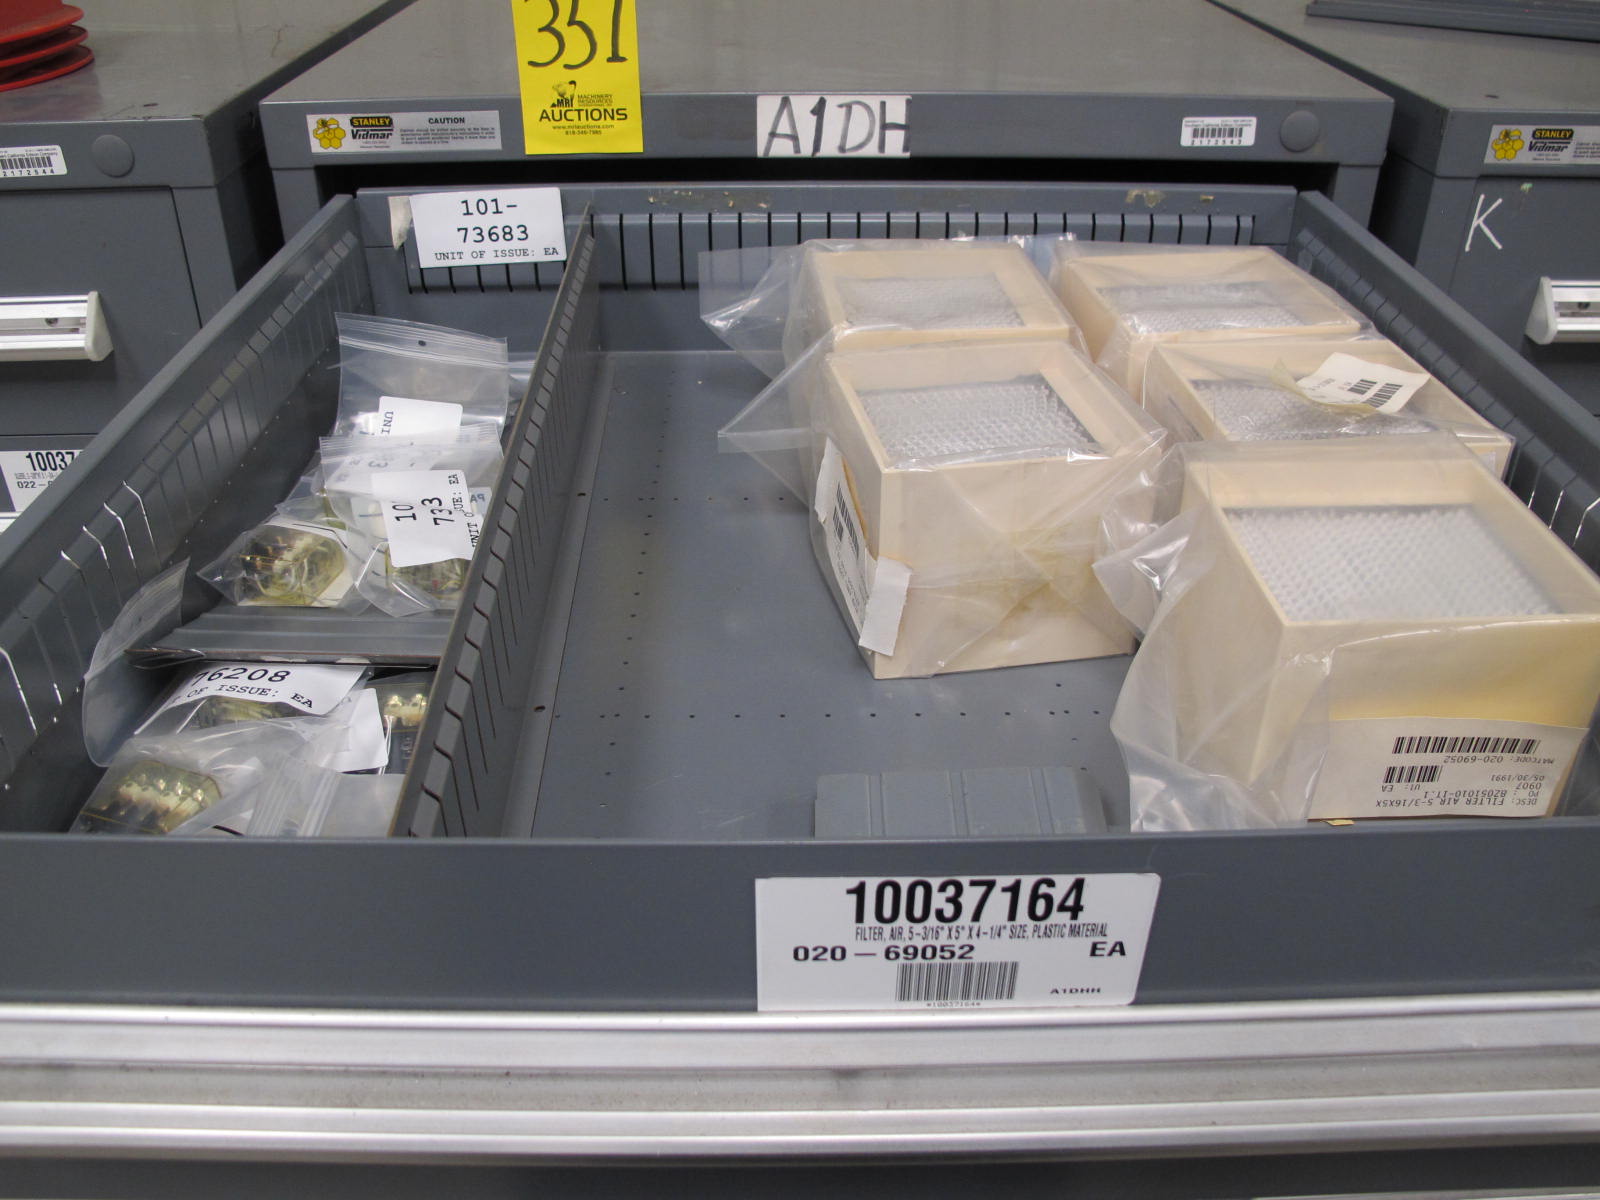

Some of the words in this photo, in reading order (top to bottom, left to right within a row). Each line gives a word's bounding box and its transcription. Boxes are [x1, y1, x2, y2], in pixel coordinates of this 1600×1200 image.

[352, 118, 391, 126] STANLEY
[539, 108, 628, 122] AUCTIONS
[763, 96, 912, 157] A1DH
[351, 129, 393, 140] Vidmar
[1534, 130, 1572, 138] STANLEY
[1528, 141, 1569, 152] Vidmar
[461, 198, 518, 216] 101-
[1465, 193, 1503, 252] K
[457, 224, 529, 244] 73683
[434, 251, 464, 261] UNIT
[471, 250, 486, 259] OF
[494, 248, 536, 258] ISSUE:
[543, 247, 559, 256] EA
[448, 473, 460, 486] EA
[392, 501, 417, 522] 10
[187, 687, 208, 698] OF
[216, 685, 279, 697] ISSUE:
[290, 692, 314, 709] EA
[1443, 756, 1504, 764] 020-69052
[1381, 784, 1394, 793] EA
[1515, 781, 1542, 790] 0907
[1439, 798, 1460, 806] AIR
[1465, 797, 1505, 806] FILTER
[845, 877, 1085, 924] 10037164
[855, 926, 887, 942] FILTER,
[890, 926, 907, 941] AIR,
[1008, 924, 1030, 941] SIZE,
[1031, 924, 1066, 938] PLASTIC
[1068, 922, 1108, 937] MATERIAL
[1089, 940, 1126, 958] EA
